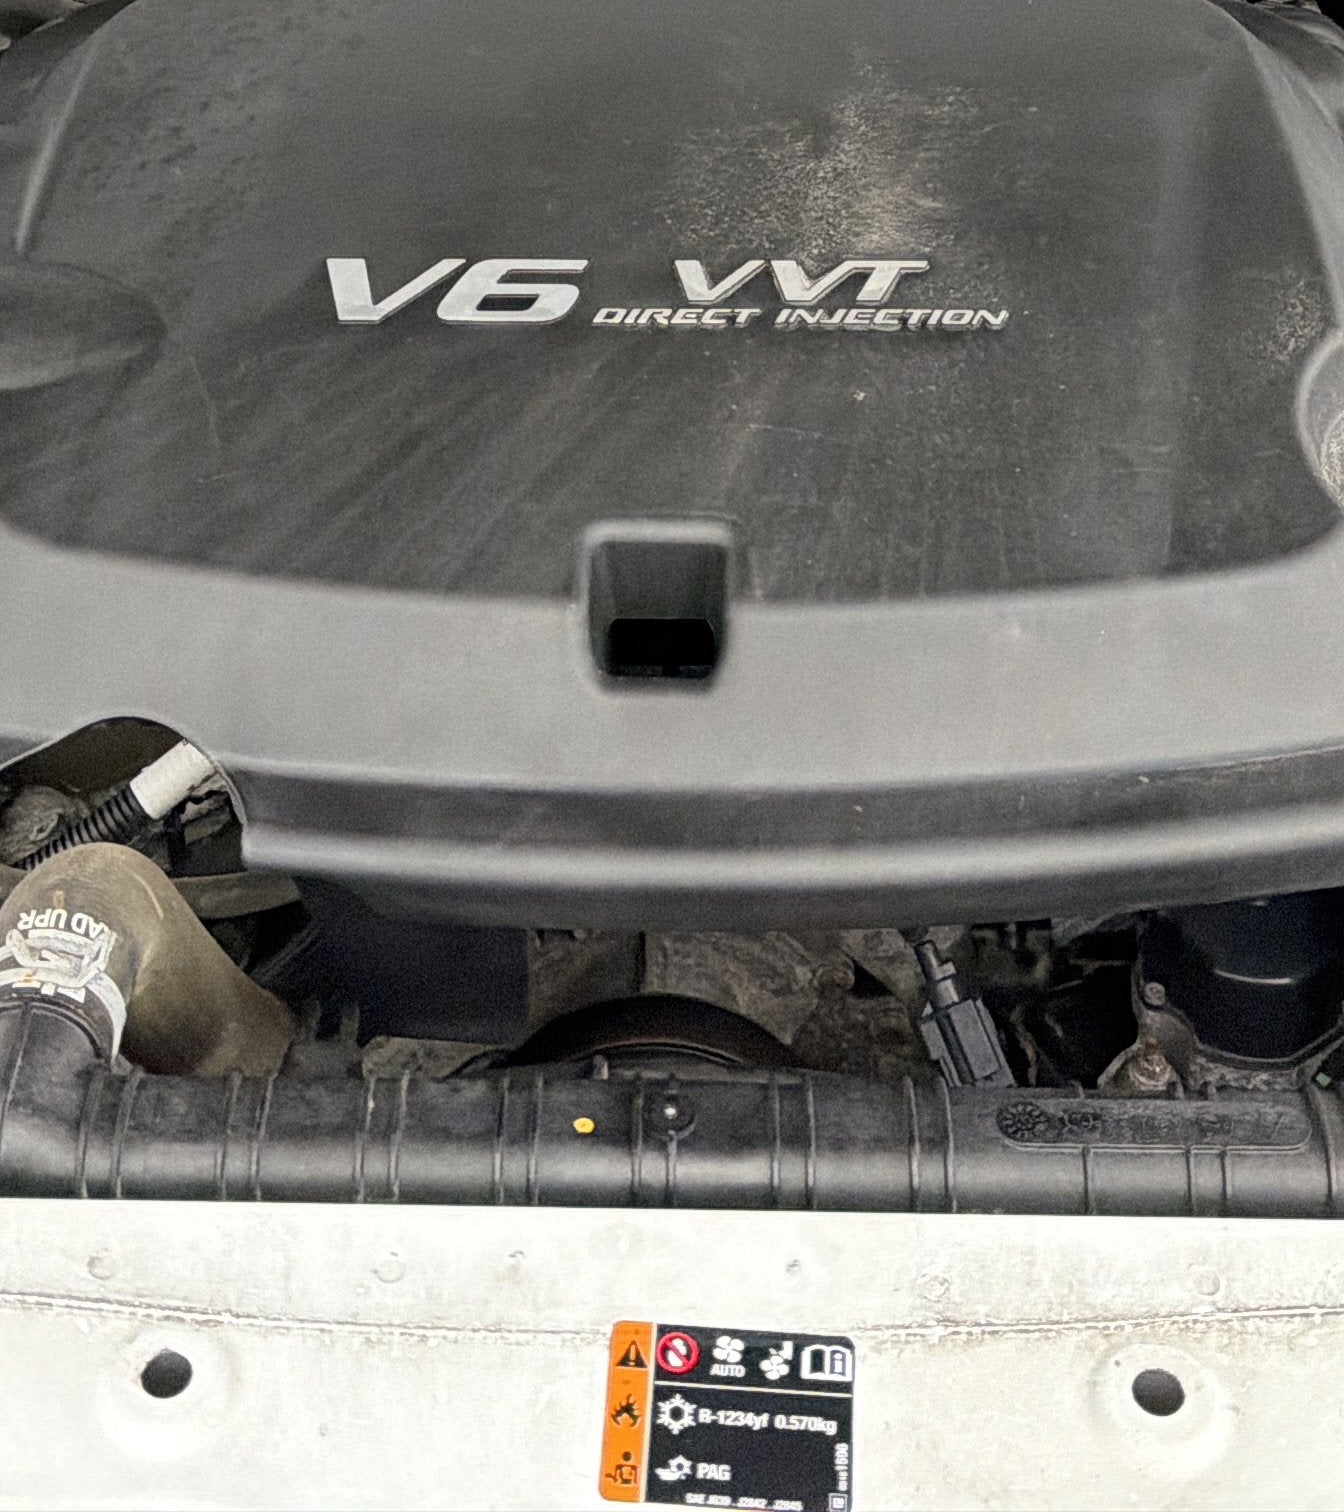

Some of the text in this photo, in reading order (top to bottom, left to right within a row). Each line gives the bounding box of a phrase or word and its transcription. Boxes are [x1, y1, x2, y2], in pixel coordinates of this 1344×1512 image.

[326, 257, 930, 326] V6 VVT
[593, 307, 1008, 329] DIRECT INJECTION
[17, 908, 110, 938] AD UPR
[709, 1363, 746, 1378] AUTO
[698, 1408, 838, 1435] R-1234yf 0.570kg
[696, 1463, 732, 1481] PAG
